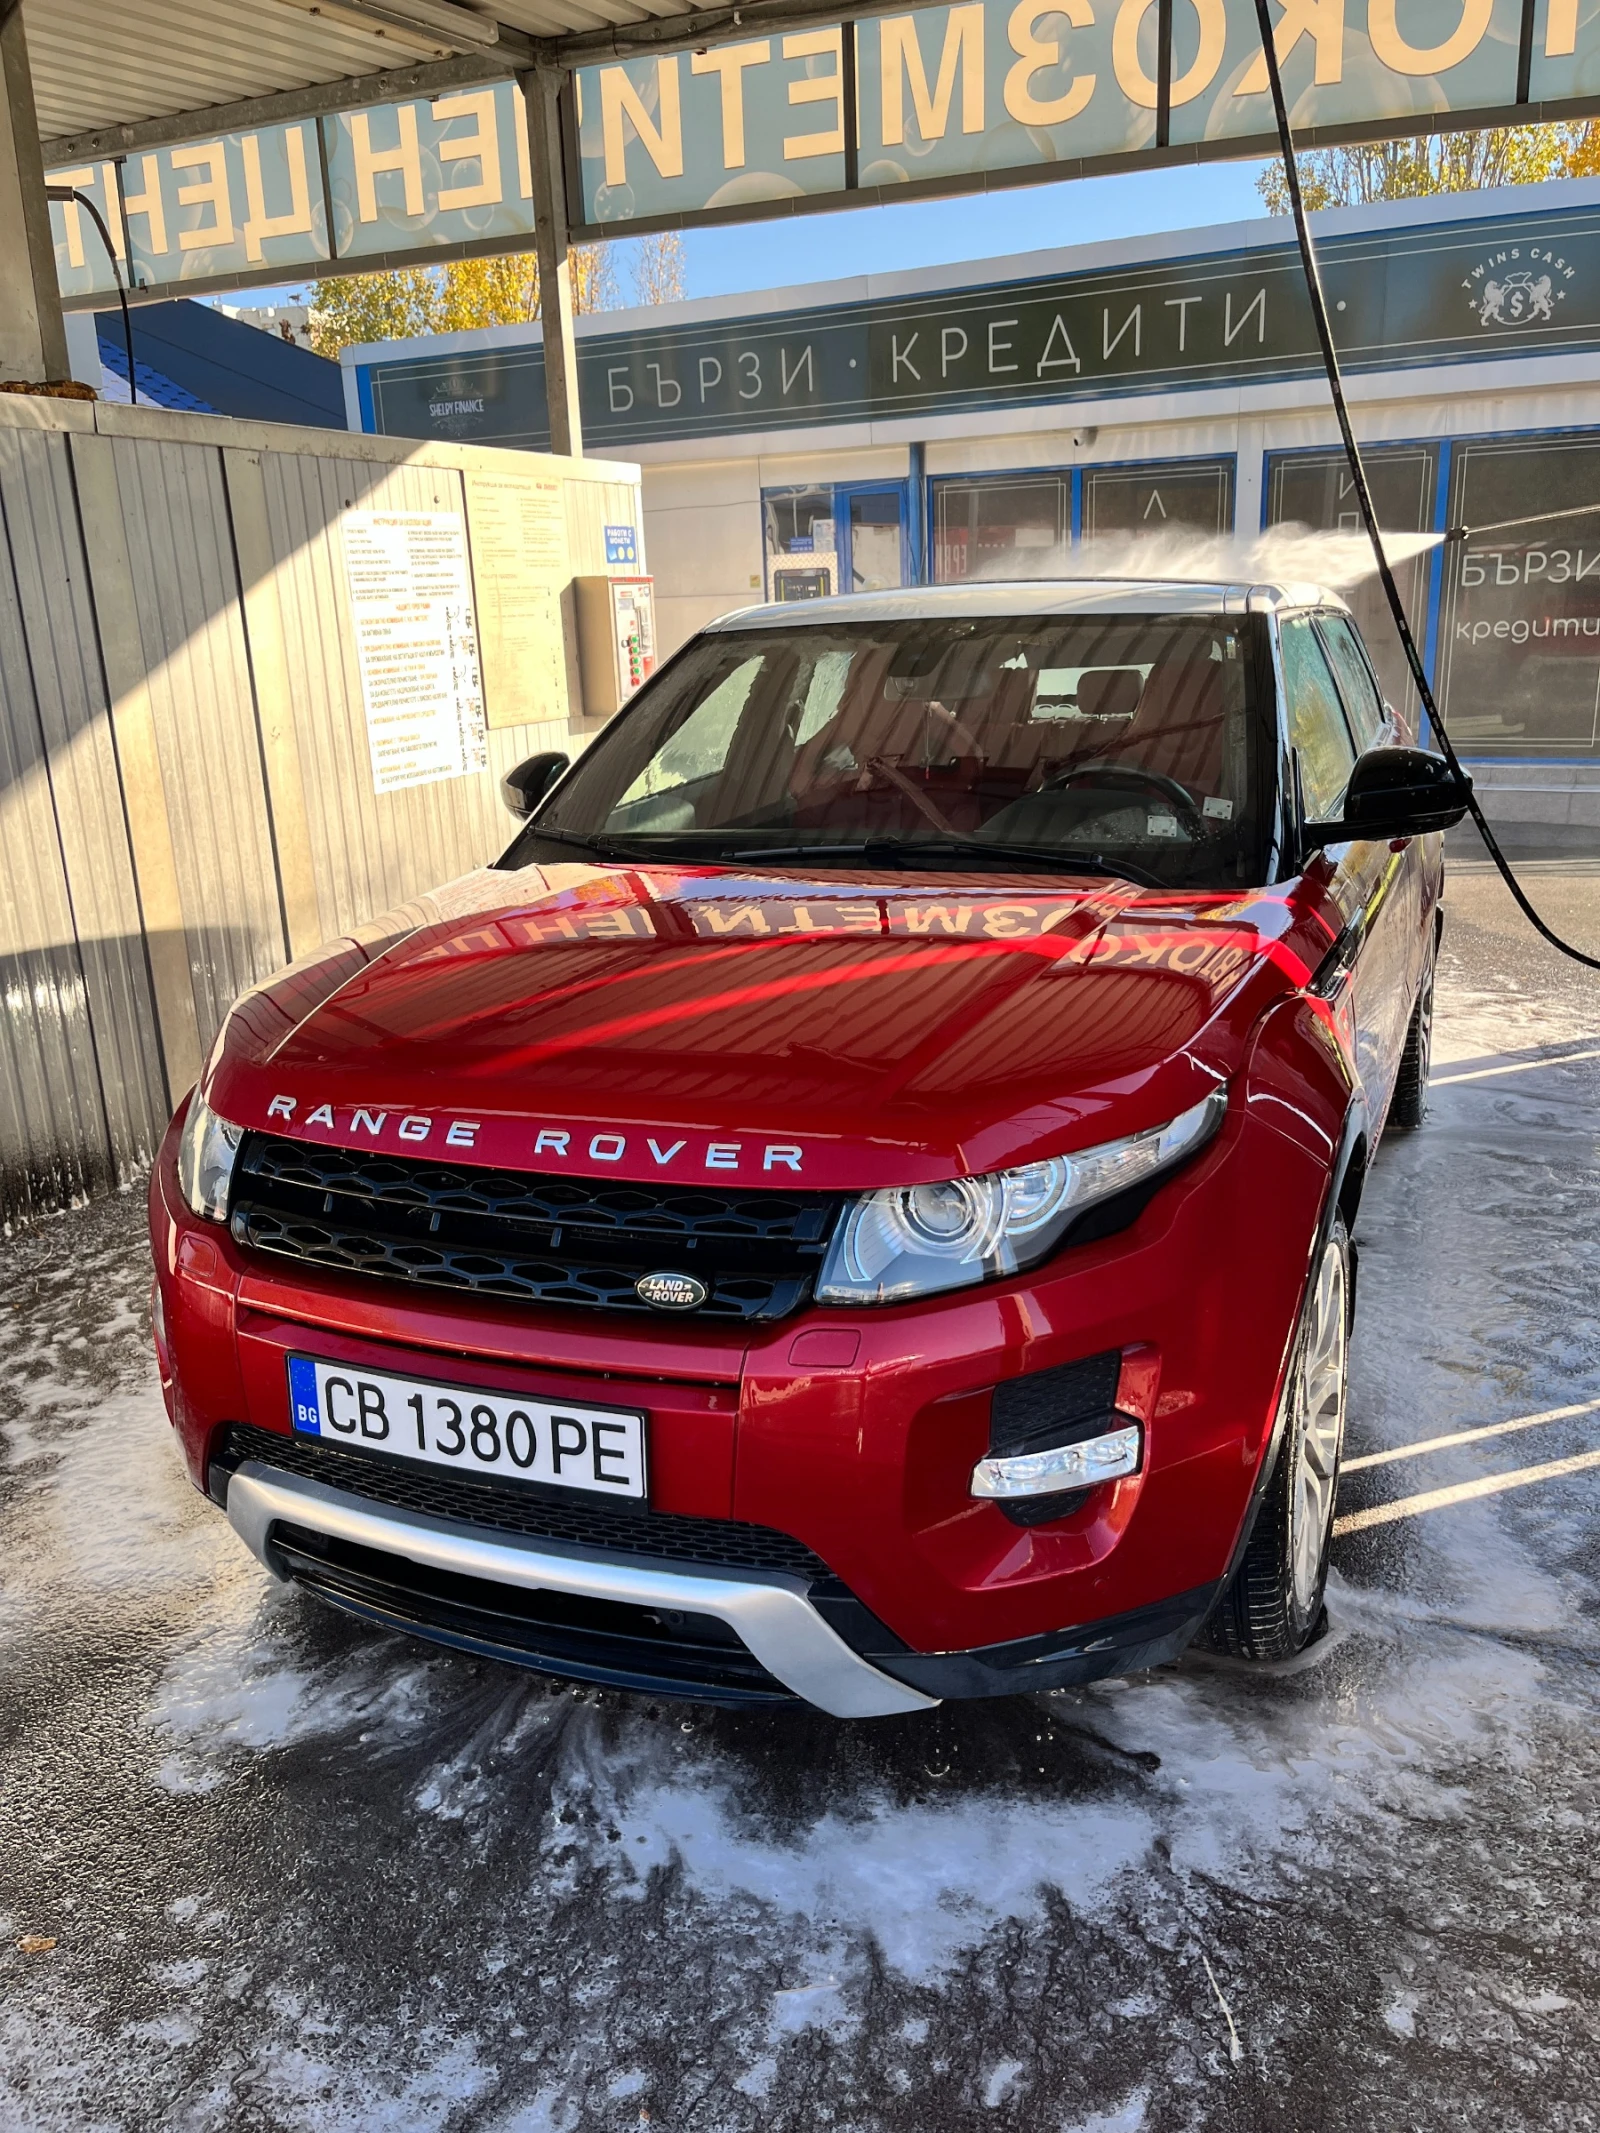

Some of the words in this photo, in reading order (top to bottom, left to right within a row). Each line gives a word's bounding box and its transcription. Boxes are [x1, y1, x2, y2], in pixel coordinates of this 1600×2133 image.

[1461, 249, 1520, 289] TWINS
[1530, 248, 1575, 279] CASH
[607, 345, 813, 413] БЪРЗИ
[891, 288, 1266, 384] КРЕДИТИ
[454, 399, 484, 414] FINANCE
[267, 1094, 480, 1147] RANGE
[534, 1129, 803, 1171] ROVER
[649, 1278, 684, 1291] LAND
[652, 1290, 694, 1303] ROVER
[296, 1403, 318, 1425] BG
[324, 1376, 390, 1440] CB
[407, 1392, 537, 1468] 1380
[550, 1415, 631, 1486] PE
